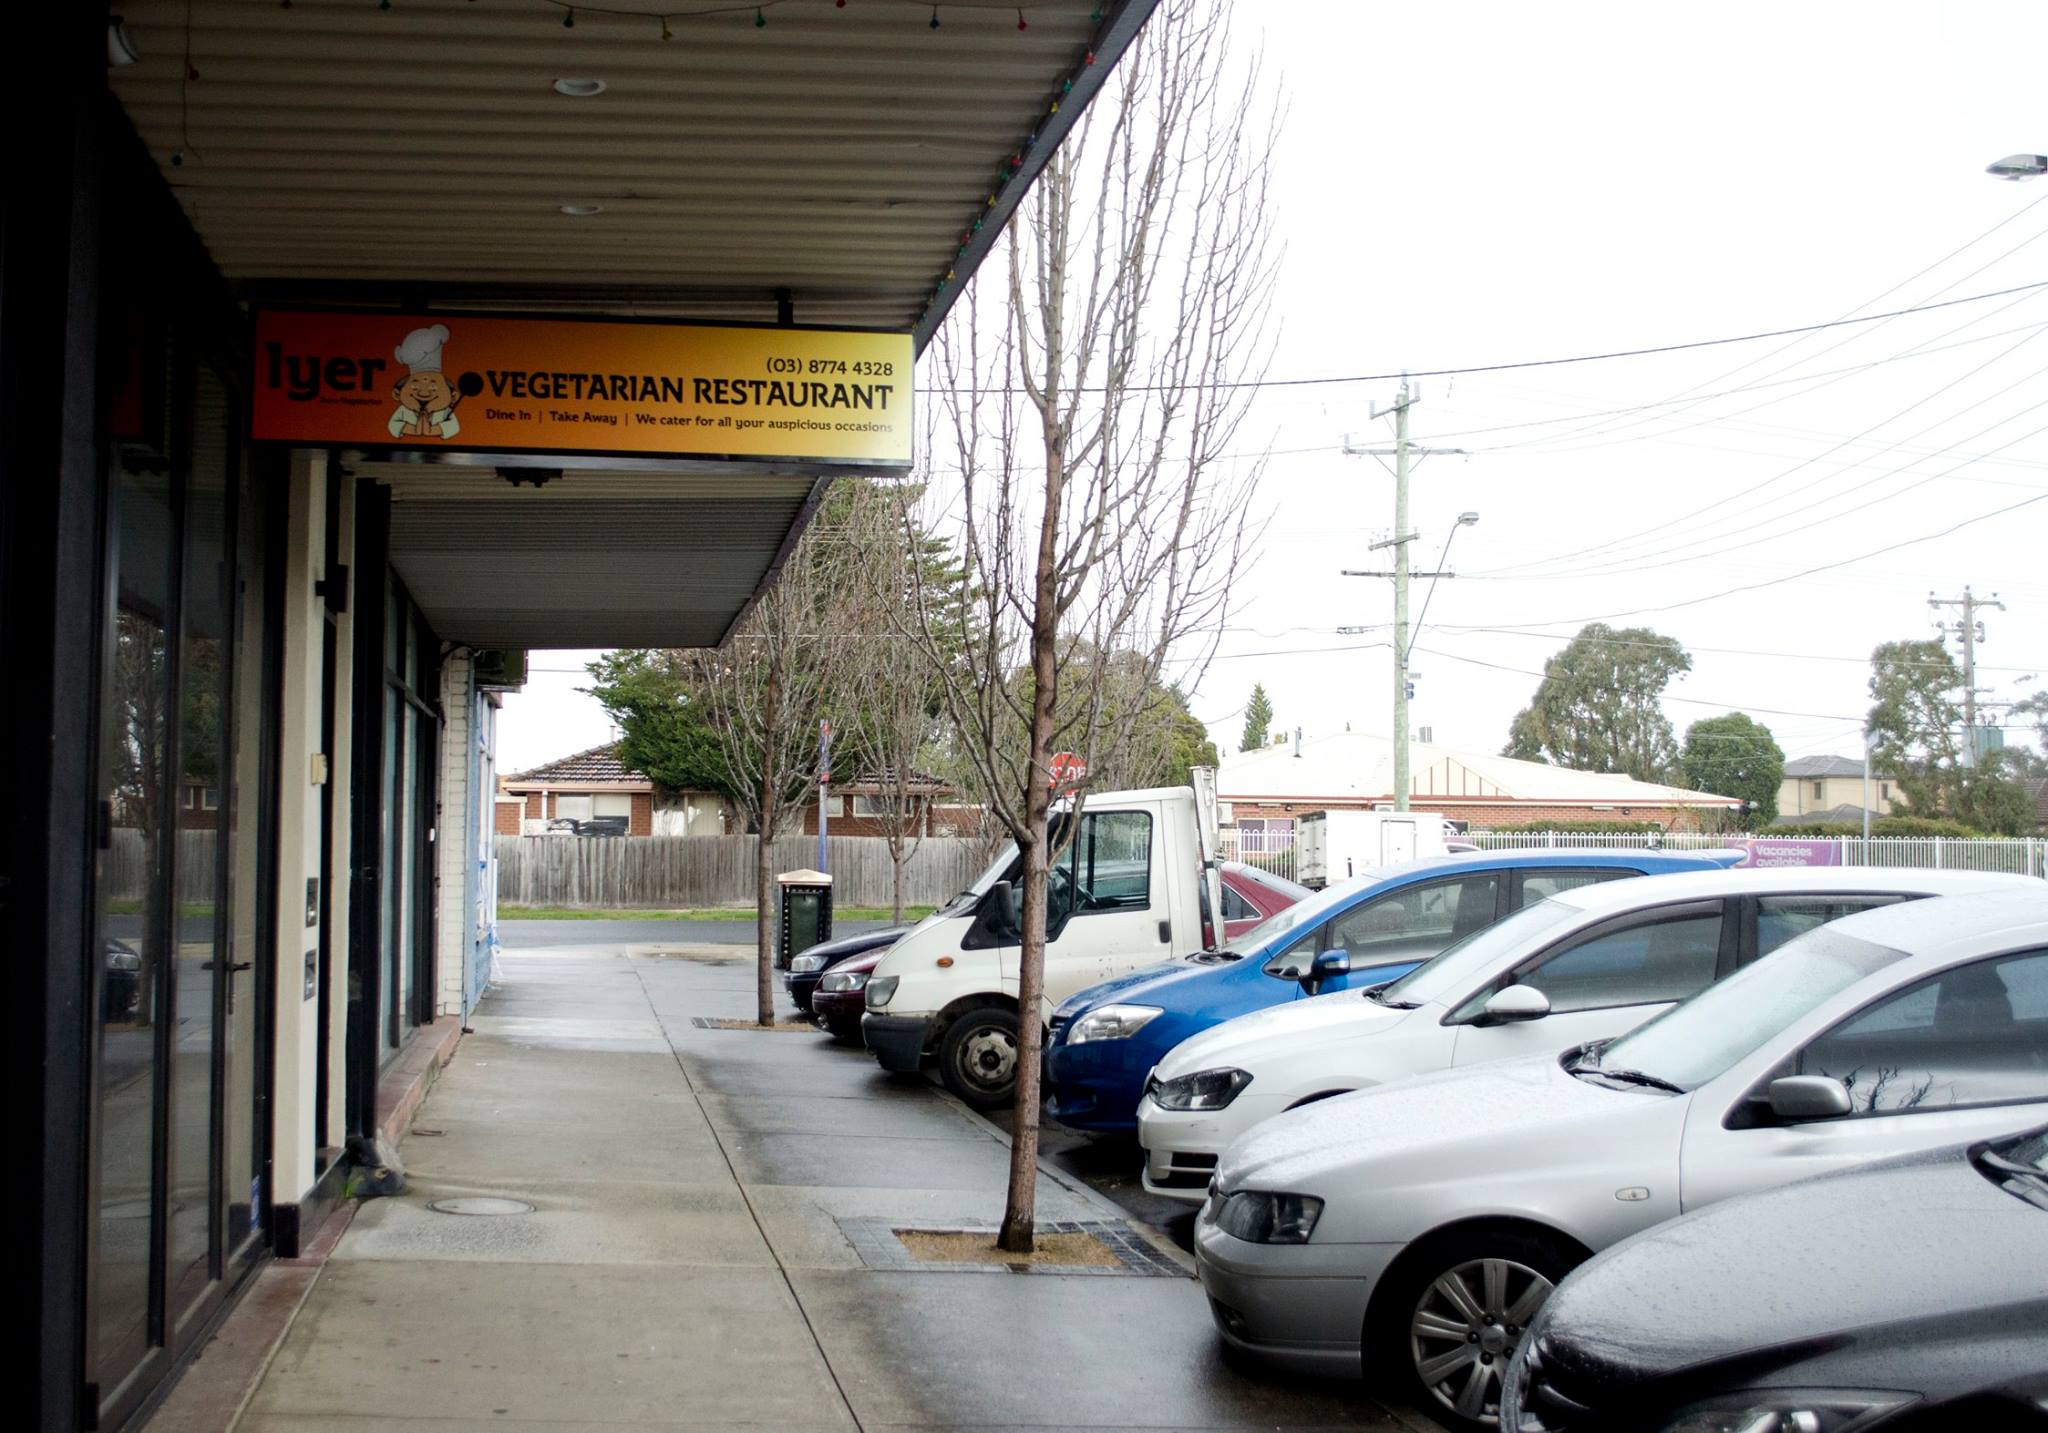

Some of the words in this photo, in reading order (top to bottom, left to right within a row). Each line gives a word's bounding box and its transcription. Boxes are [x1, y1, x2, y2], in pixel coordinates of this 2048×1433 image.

[265, 341, 386, 401] Iyer
[766, 357, 803, 375] (03)
[808, 360, 847, 375] 8774
[852, 361, 893, 377] 4328
[486, 370, 683, 403] VEGETARIAN
[693, 377, 894, 410] RESTAURANT
[486, 408, 515, 421] Dine
[550, 410, 579, 423] Take
[582, 412, 618, 426] Away
[636, 413, 657, 425] We
[660, 414, 692, 426] cater
[696, 416, 713, 427] for
[718, 417, 732, 428] all
[735, 419, 765, 430] your
[768, 419, 832, 432] auspicious
[835, 421, 894, 433] occasions
[1756, 845, 1812, 856] Vacancies
[1756, 857, 1807, 867] available
